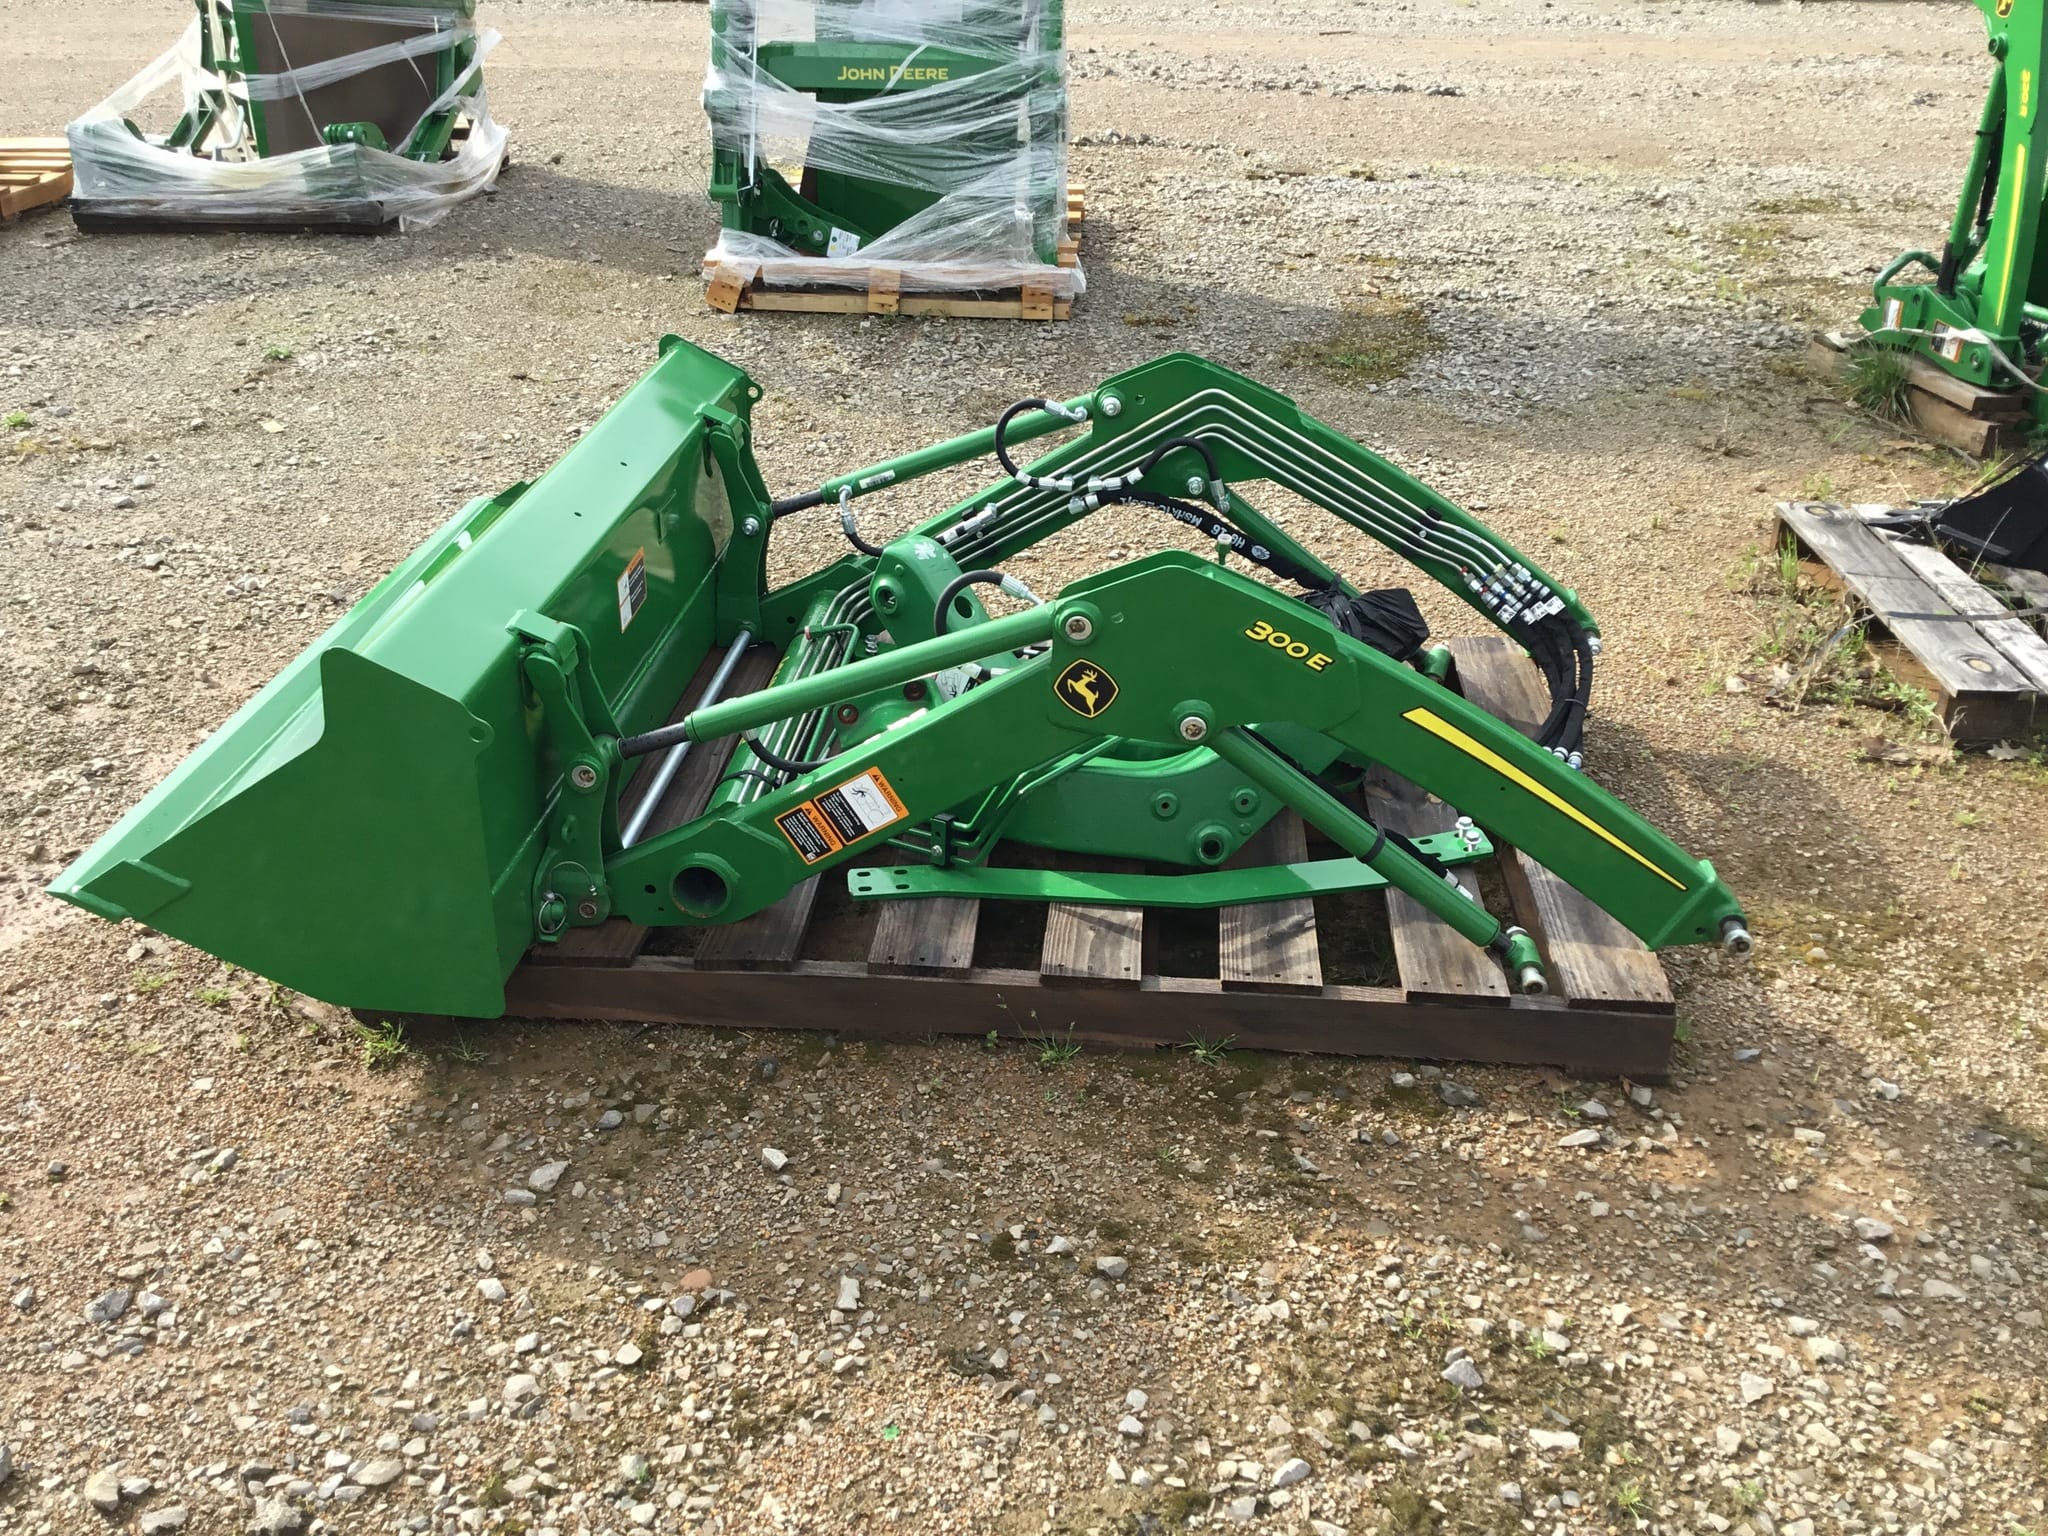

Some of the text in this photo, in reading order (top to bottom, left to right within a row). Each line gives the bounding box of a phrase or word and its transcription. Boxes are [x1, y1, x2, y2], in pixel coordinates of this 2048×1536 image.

[837, 65, 885, 81] JOHN
[878, 782, 903, 813] WARNING
[812, 815, 837, 847] WARNING
